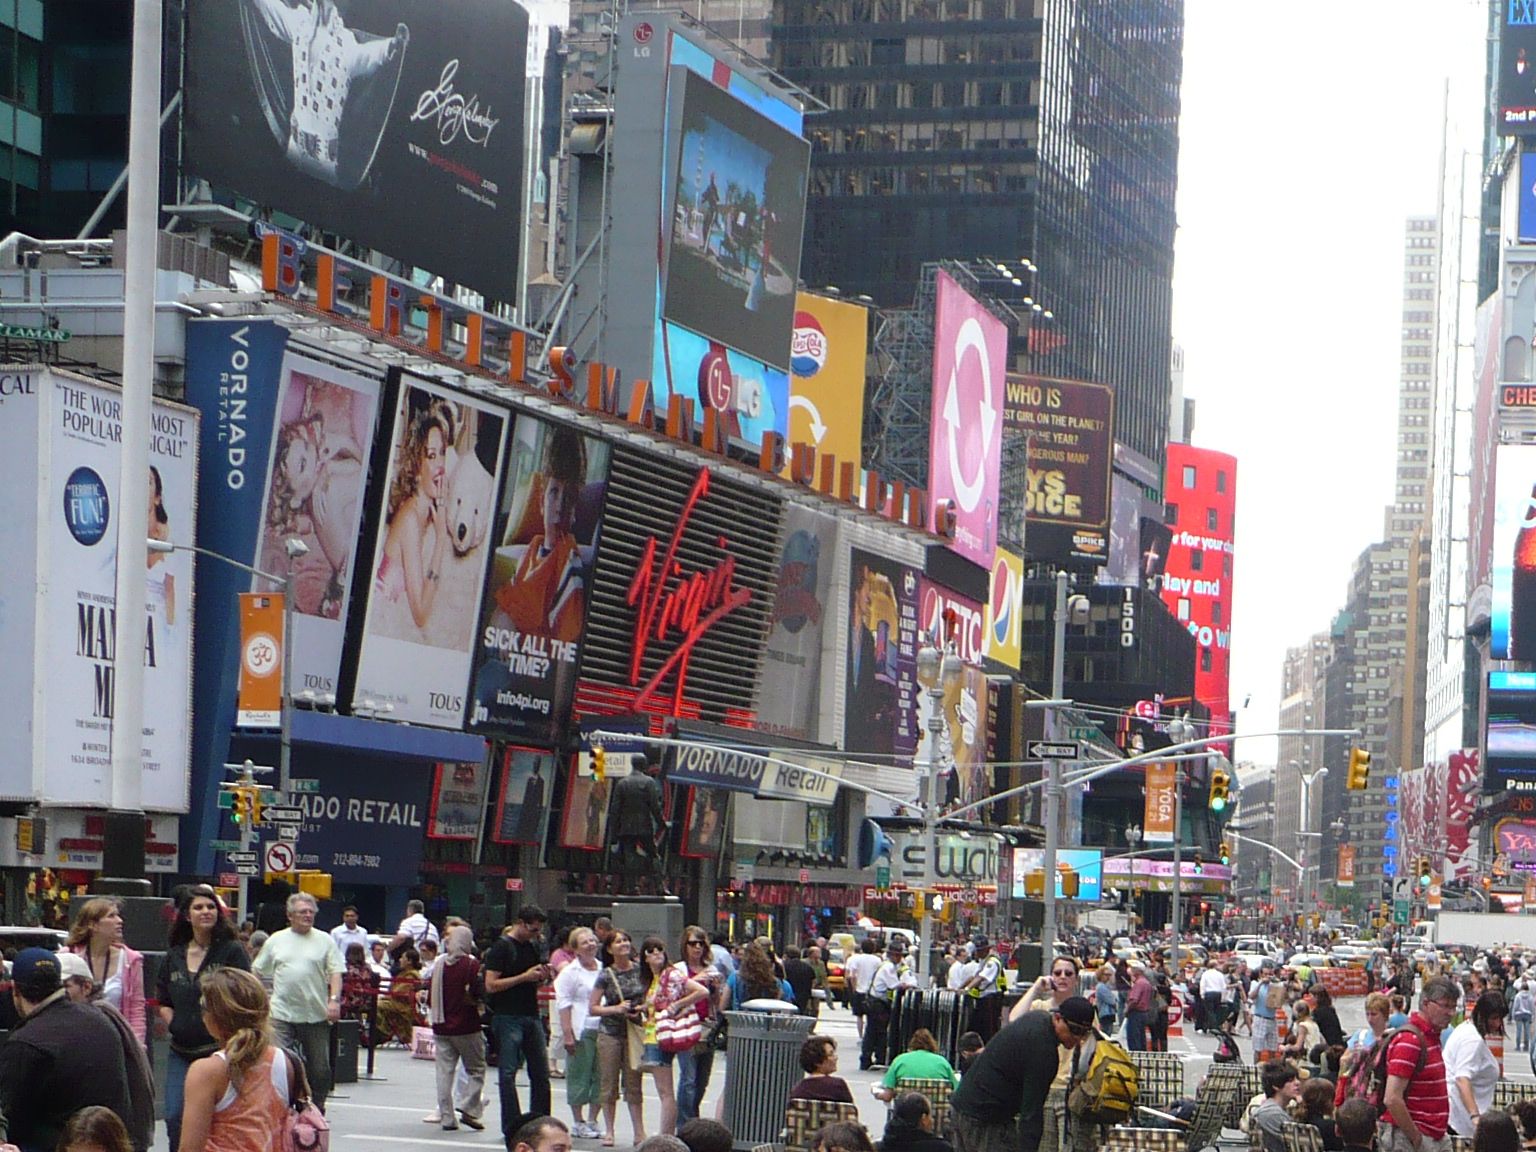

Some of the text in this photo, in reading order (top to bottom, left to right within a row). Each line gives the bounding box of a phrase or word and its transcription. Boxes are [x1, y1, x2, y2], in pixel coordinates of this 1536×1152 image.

[633, 47, 650, 57] LG
[1505, 110, 1527, 121] 2nd
[5, 326, 65, 341] LAMAR
[91, 395, 122, 421] WOR
[217, 372, 229, 442] RETAIL
[227, 326, 251, 490] VORNADO
[1006, 382, 1062, 409] WHO IS
[1016, 409, 1105, 432] GIRL ON THE PLANET?
[1053, 431, 1079, 446] YEAR?
[760, 430, 957, 538] BUILDING
[1180, 531, 1224, 550] for your
[627, 466, 752, 717] Virgin
[1193, 578, 1220, 594] and
[1120, 587, 1134, 647] 1500
[484, 626, 577, 662] SICK ALL THE
[508, 652, 549, 679] TIME?
[304, 674, 332, 691] TOUS
[1508, 676, 1534, 686] News
[429, 692, 462, 712] TOUS
[497, 690, 549, 714] info4pi.org
[675, 745, 829, 791] VORNADO Retail
[347, 798, 421, 827] RETAIL
[1158, 787, 1171, 822] YOGA
